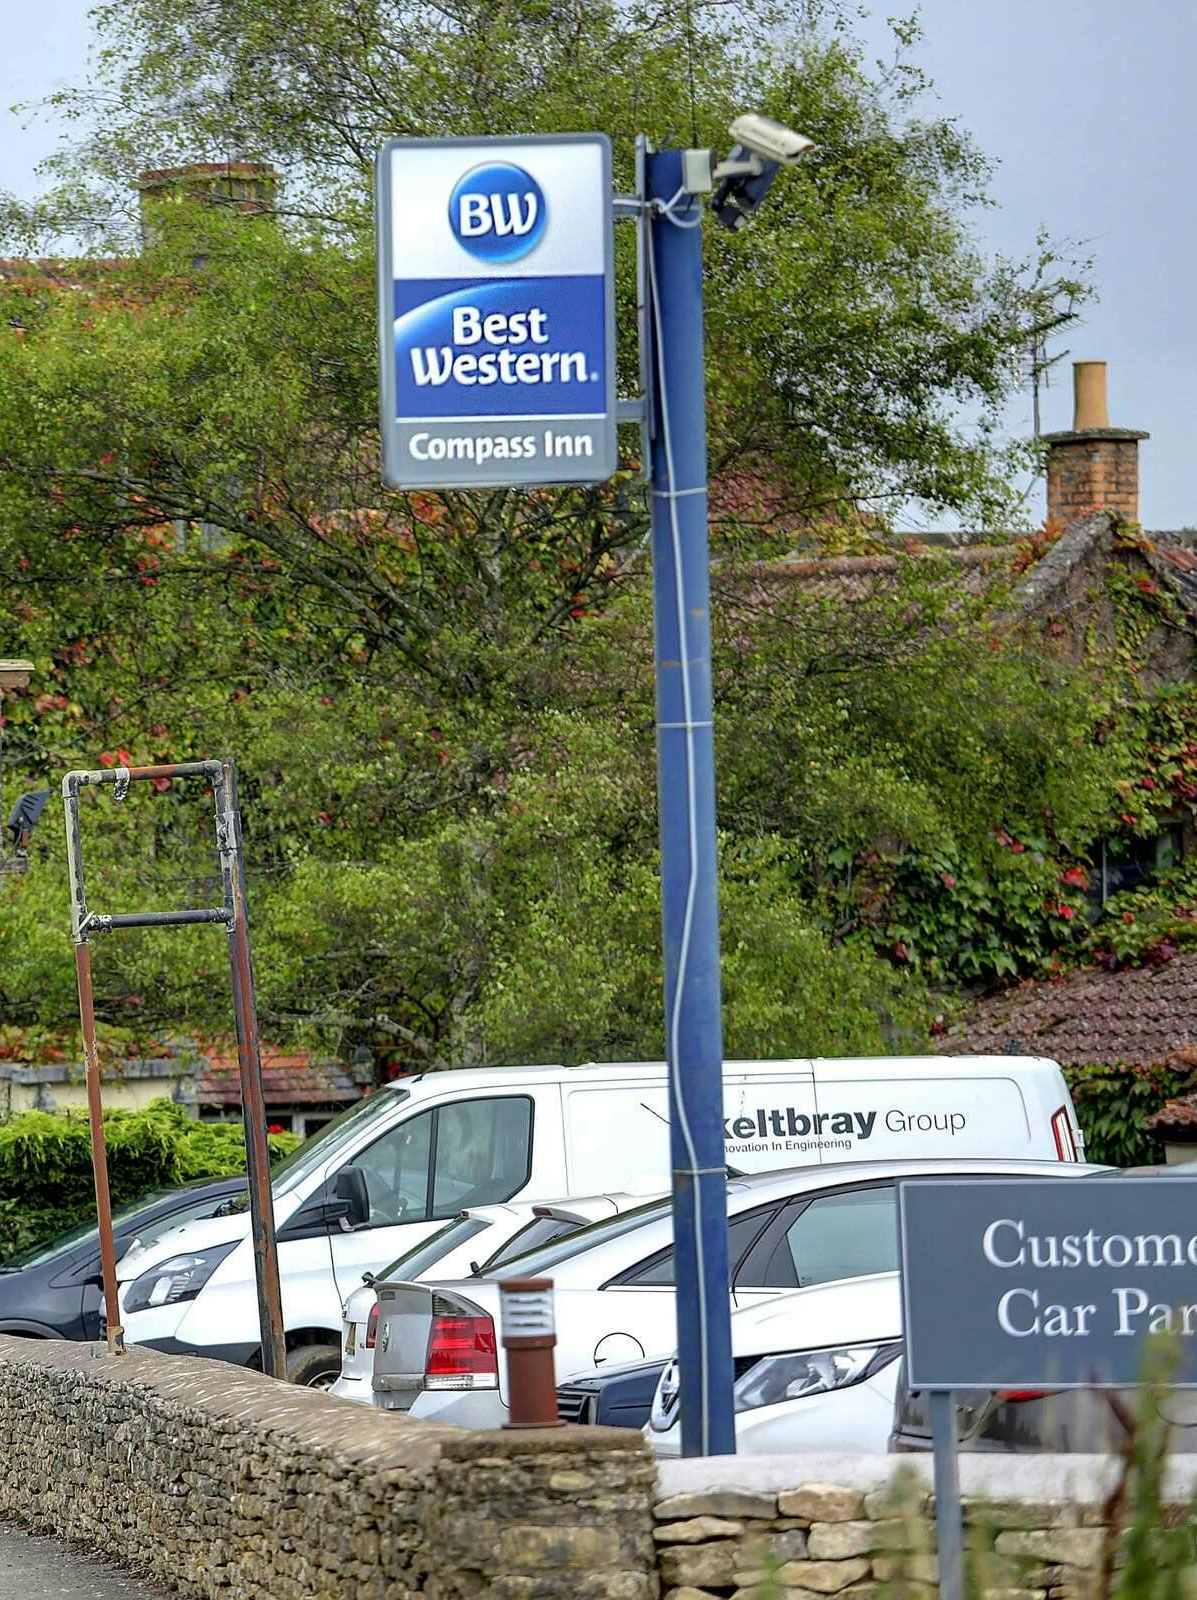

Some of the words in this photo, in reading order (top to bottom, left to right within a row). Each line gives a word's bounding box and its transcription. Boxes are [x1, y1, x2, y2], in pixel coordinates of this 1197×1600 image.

[459, 193, 537, 236] BW
[453, 307, 548, 345] Best
[411, 347, 587, 385] Western
[409, 434, 535, 464] Compass
[545, 431, 592, 456] Inn
[885, 1110, 966, 1133] Group
[772, 1142, 782, 1151] In
[785, 1139, 852, 1151] Engineering
[997, 1288, 1097, 1337] Car
